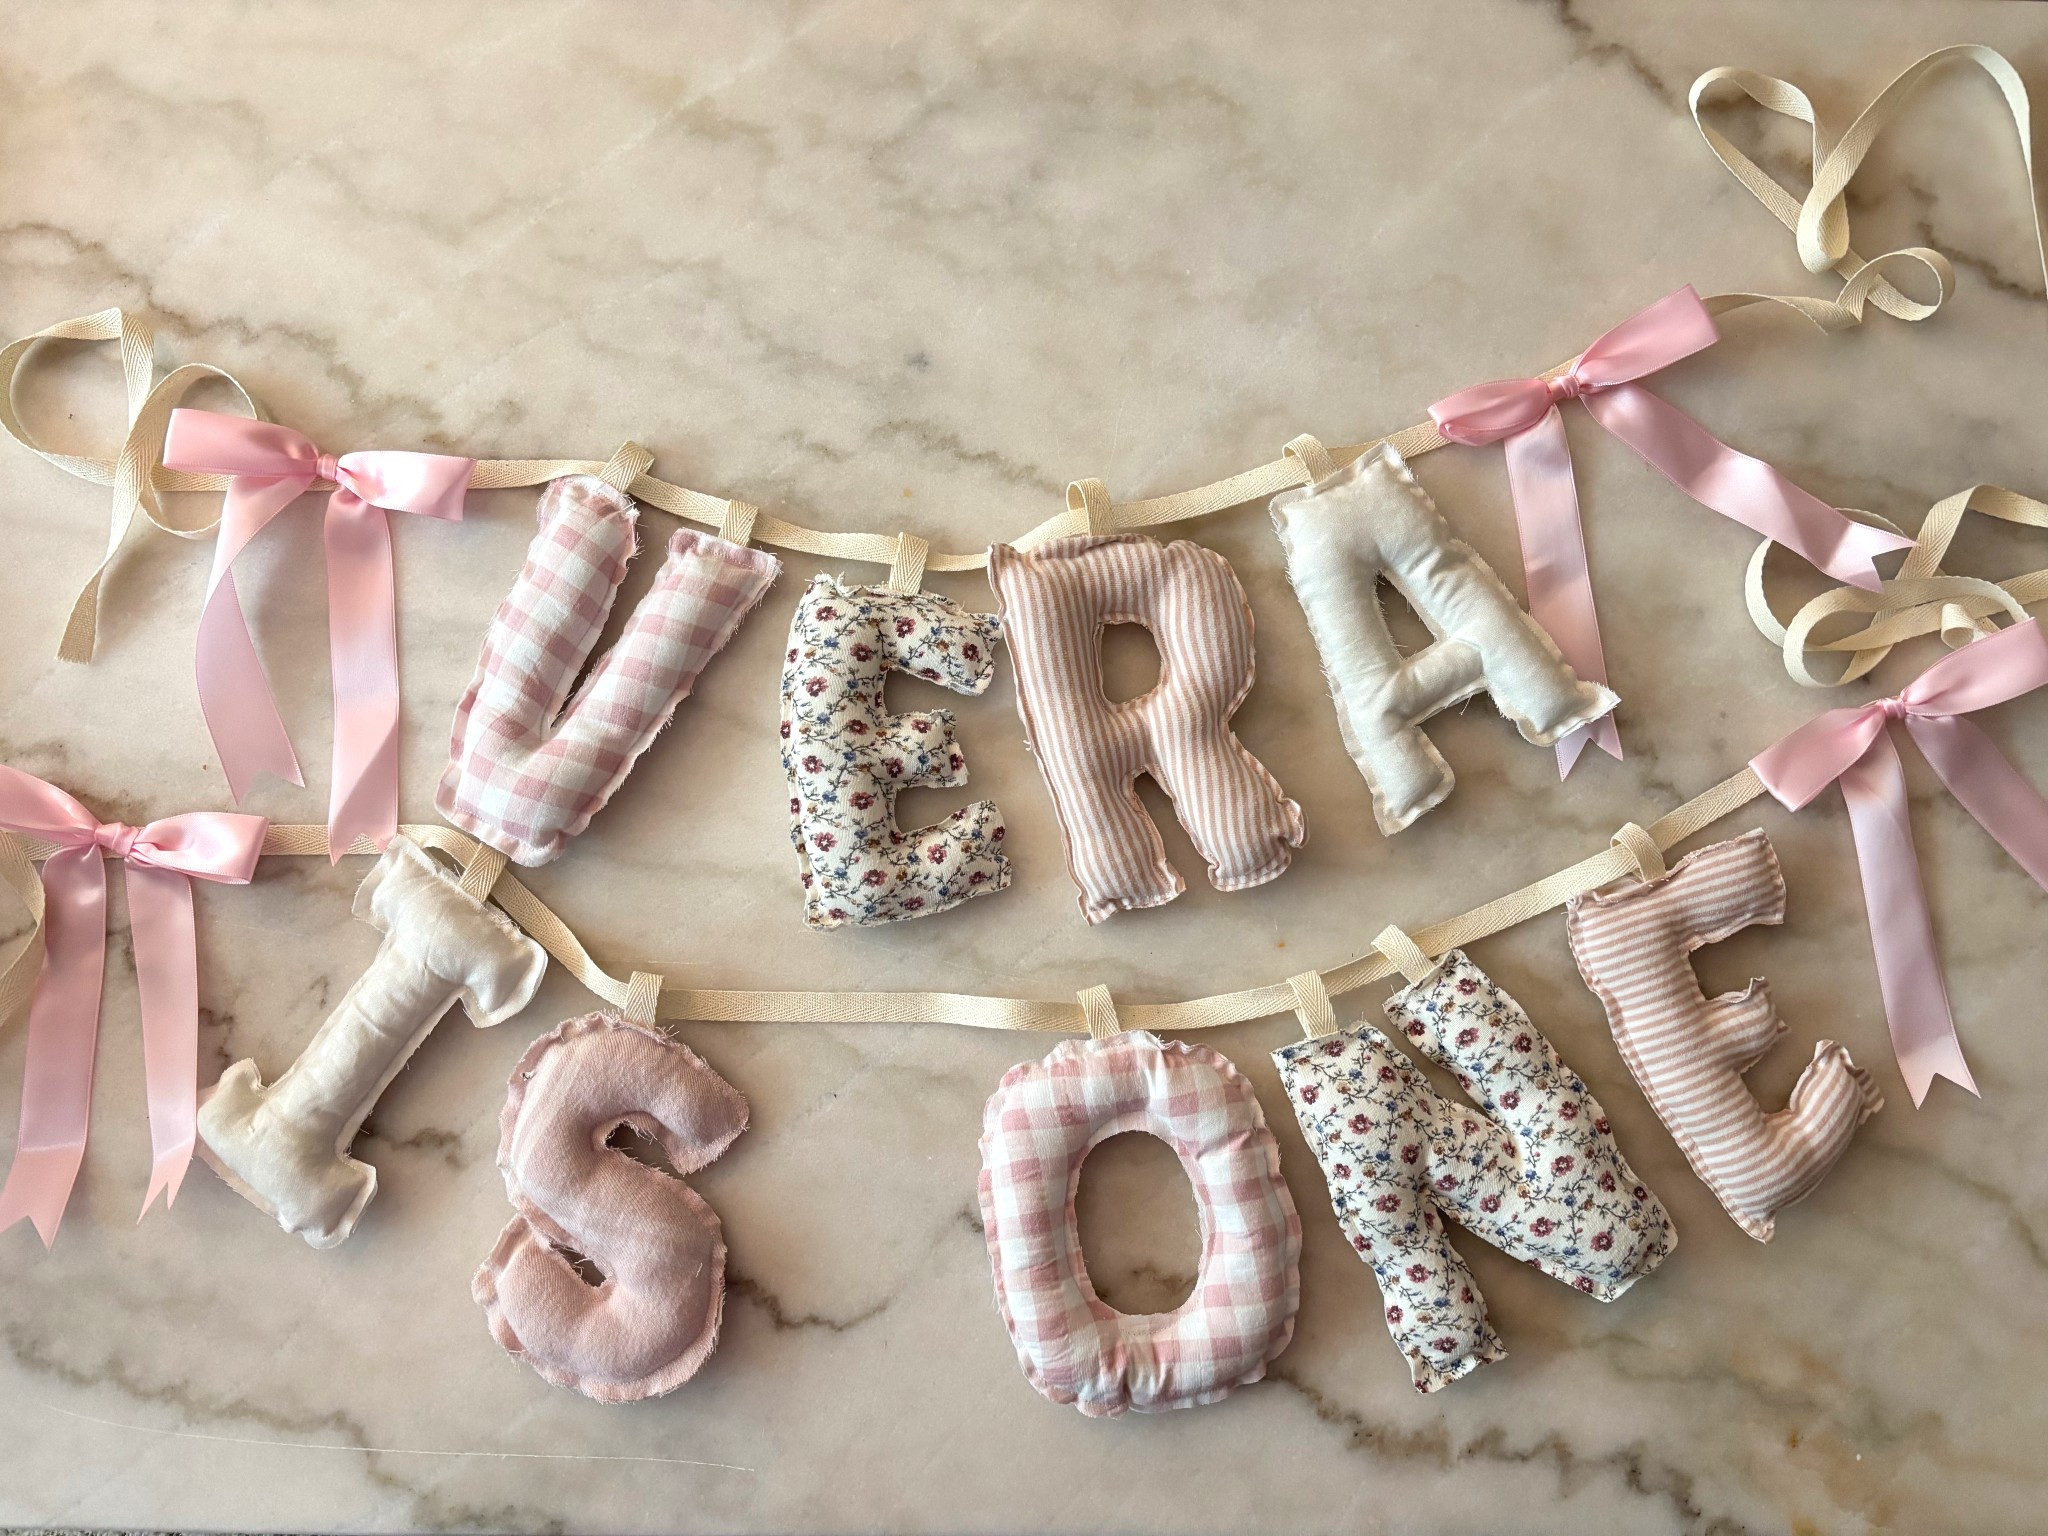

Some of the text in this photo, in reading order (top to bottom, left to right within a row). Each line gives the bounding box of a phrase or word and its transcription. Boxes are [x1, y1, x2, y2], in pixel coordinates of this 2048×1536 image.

[437, 442, 1620, 929] VERA
[197, 828, 1884, 1416] IS ONE
